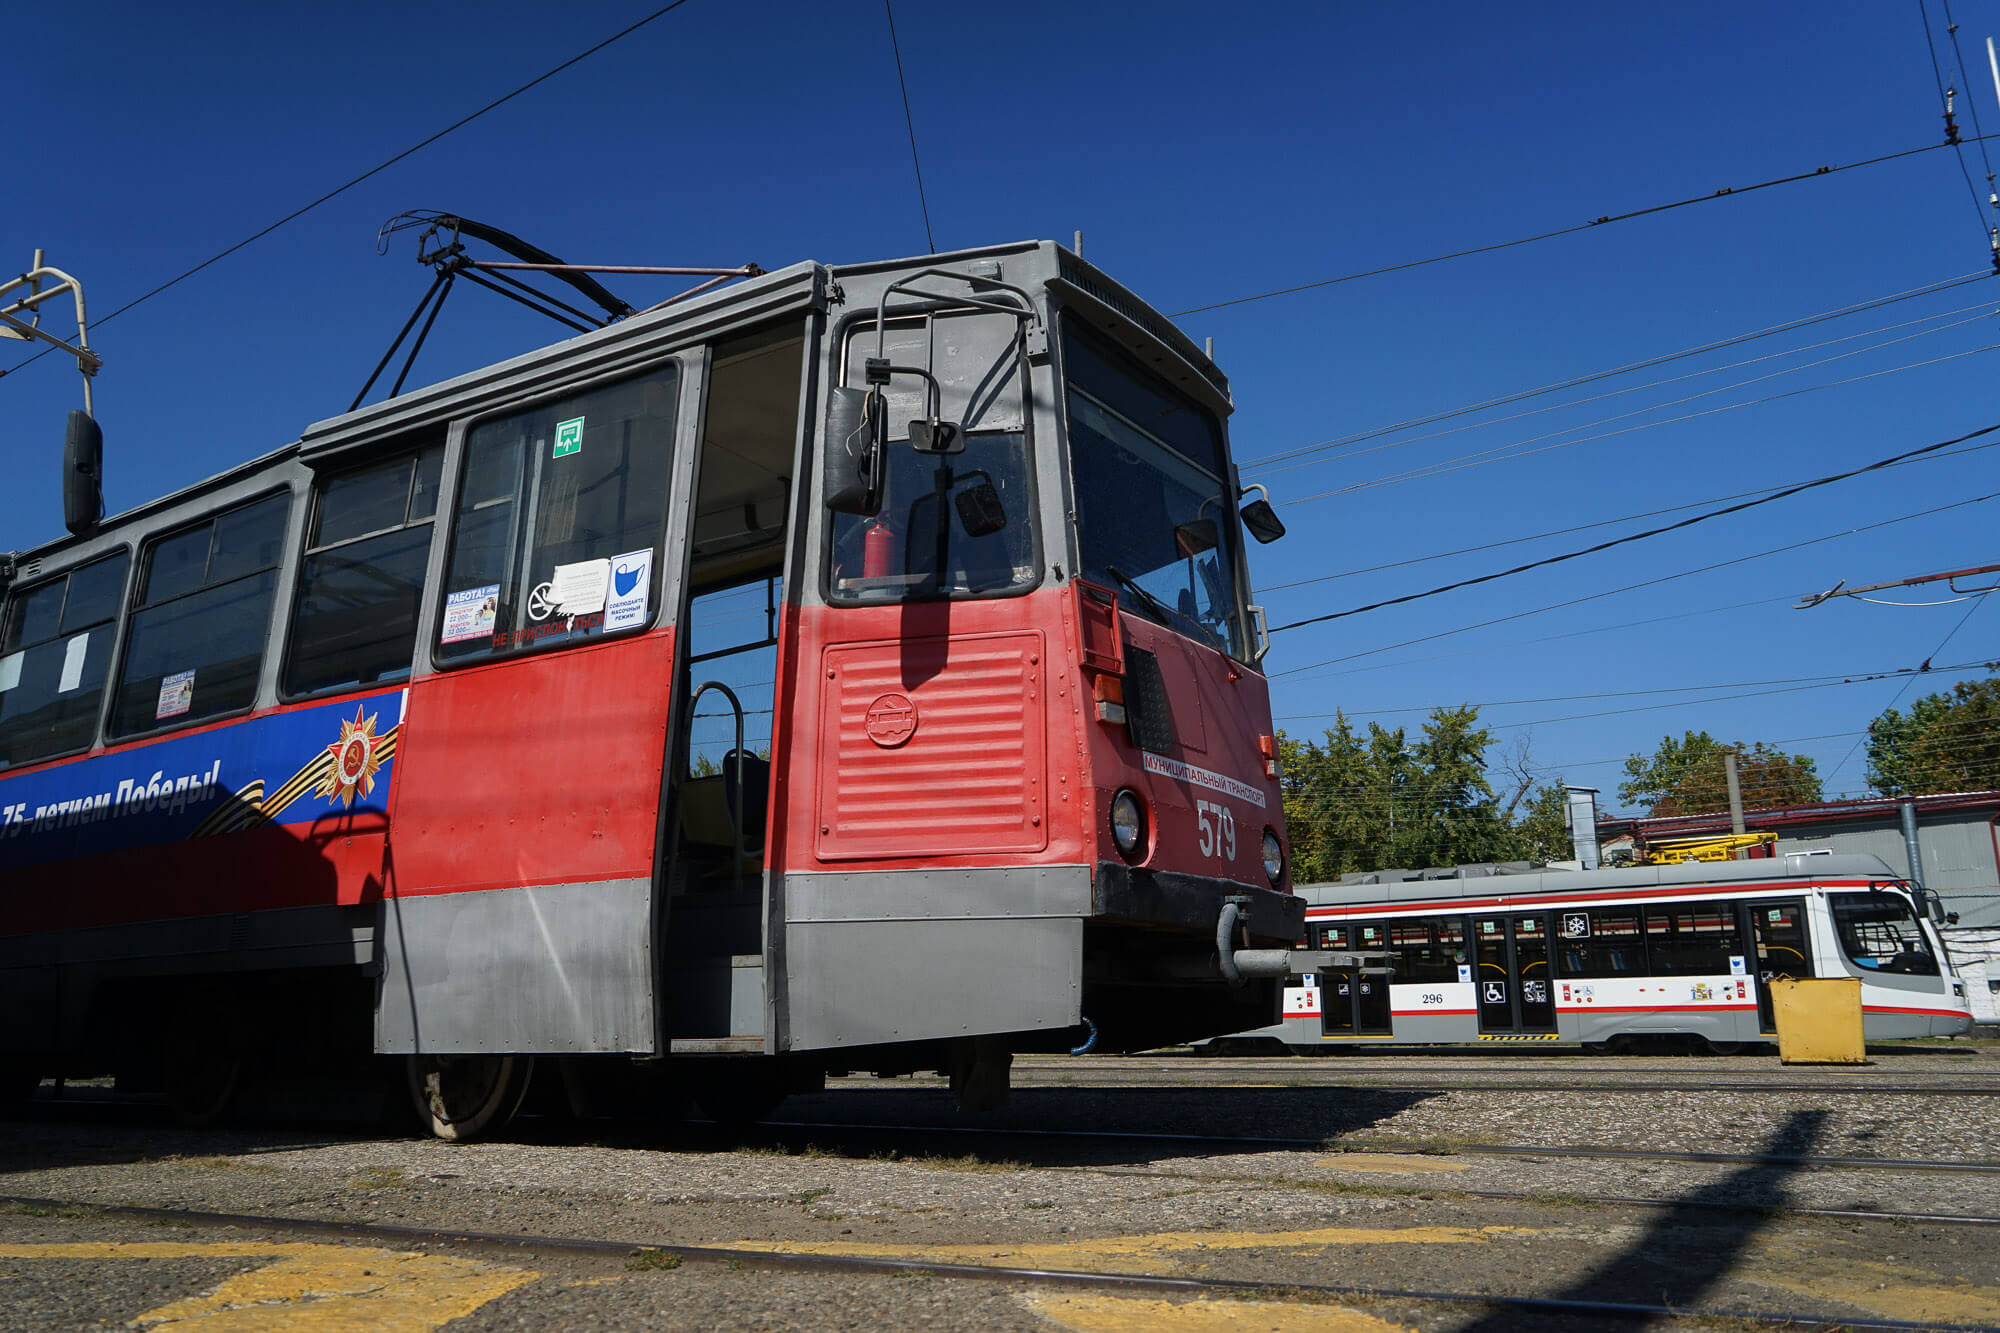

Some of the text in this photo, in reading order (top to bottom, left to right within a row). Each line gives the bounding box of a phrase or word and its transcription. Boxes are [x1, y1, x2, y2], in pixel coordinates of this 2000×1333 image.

[448, 588, 485, 604] РАБОТА!
[609, 597, 645, 610] СОБЛЮДАЙТЕ
[611, 605, 641, 616] МАСОЧНЫЙ
[614, 612, 636, 622] РЕЖИМ!
[492, 612, 604, 649] НЕ ПРИСЛОНТЬСЯ
[112, 759, 221, 818] Победы!
[1144, 754, 1265, 807] МУНИЦИПАЛЬНЫЙ ТРАНСПОРТ
[1197, 800, 1236, 862] 579
[1422, 993, 1443, 1004] 296
